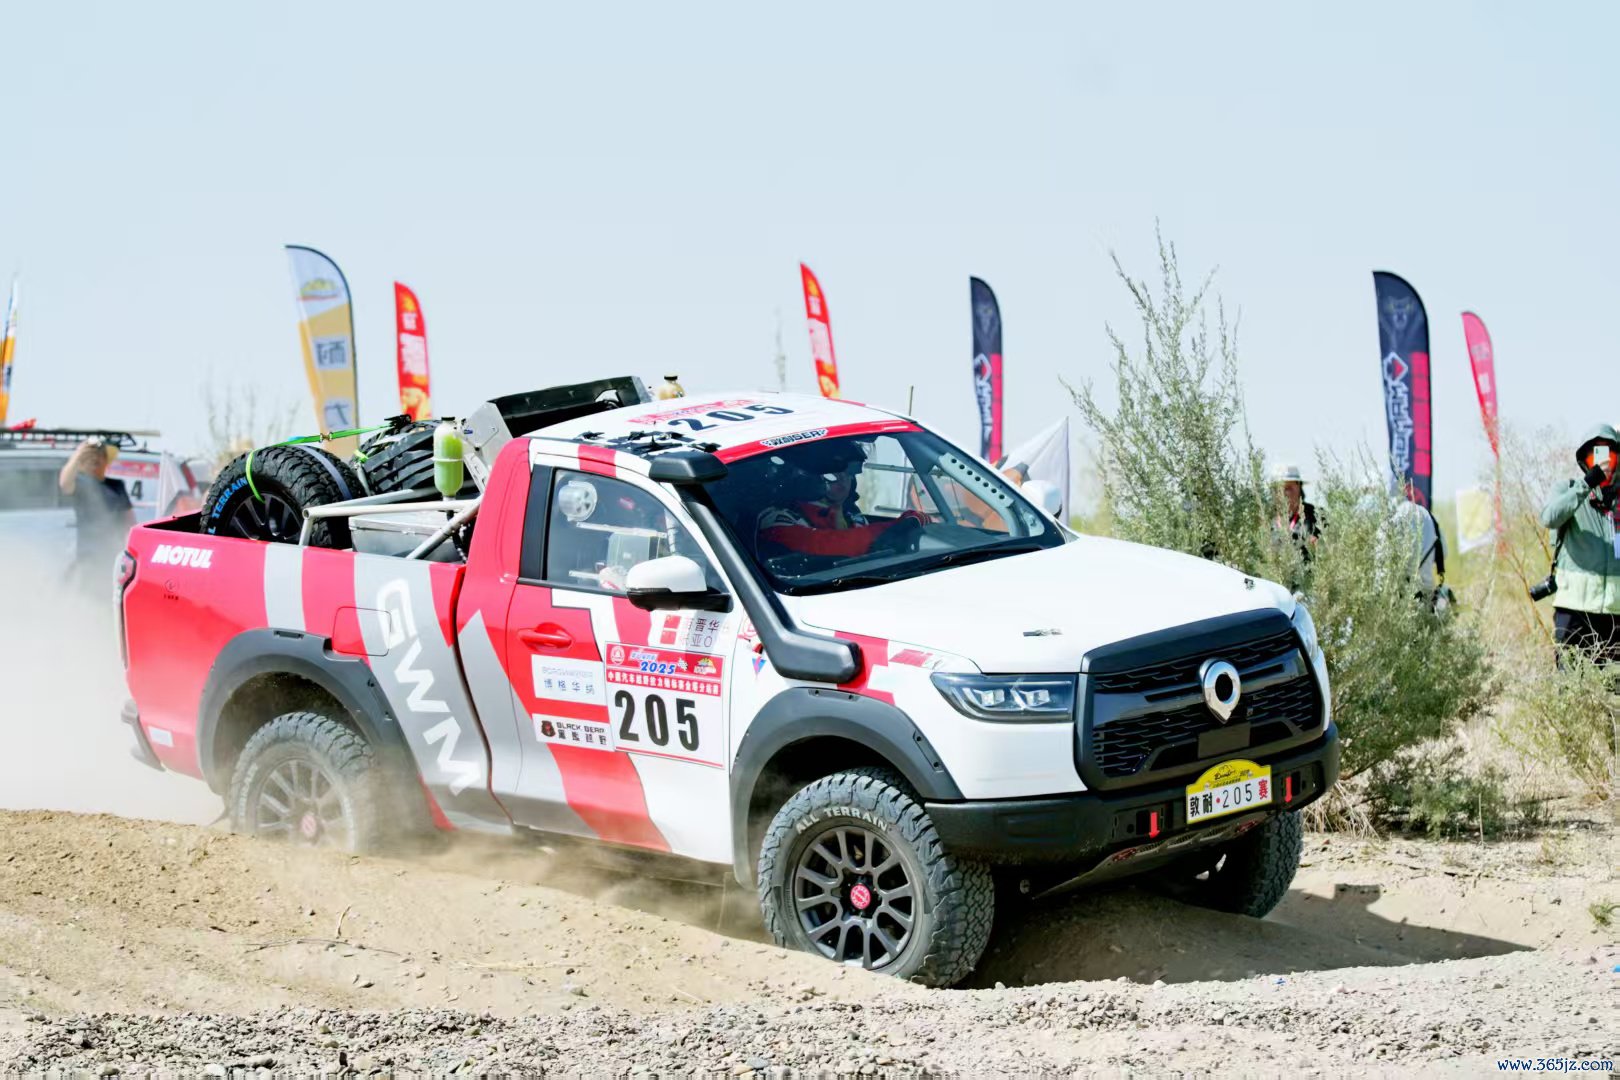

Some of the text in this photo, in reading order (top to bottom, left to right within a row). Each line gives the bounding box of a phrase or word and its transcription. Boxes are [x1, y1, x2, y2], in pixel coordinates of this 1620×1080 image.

[668, 403, 795, 431] 205
[211, 476, 248, 519] TERRAIN
[151, 544, 214, 569] MOTUL
[640, 661, 676, 675] 2025
[376, 578, 481, 796] GWM
[556, 721, 581, 731] BLACK
[614, 689, 700, 752] 205
[795, 806, 888, 835] ALL TERRAIN
